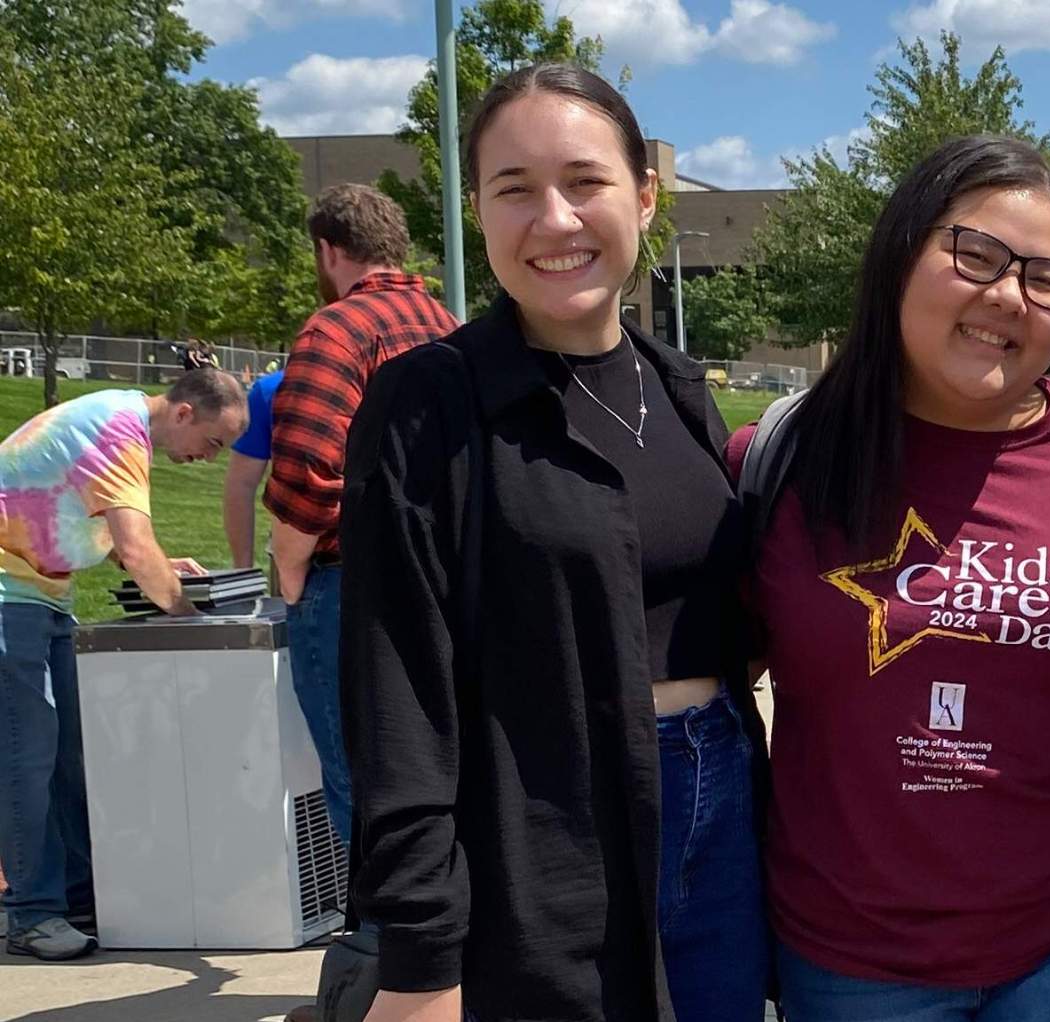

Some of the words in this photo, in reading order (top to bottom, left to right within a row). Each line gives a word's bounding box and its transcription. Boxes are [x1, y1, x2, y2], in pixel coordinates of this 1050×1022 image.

[929, 610, 978, 630] 2024
[896, 736, 929, 748] College
[931, 738, 941, 746] of
[943, 738, 992, 751] Engineering
[901, 748, 917, 756] and
[919, 748, 954, 760] Polymer
[956, 750, 987, 760] Science
[902, 758, 916, 766] The
[955, 762, 963, 770] of
